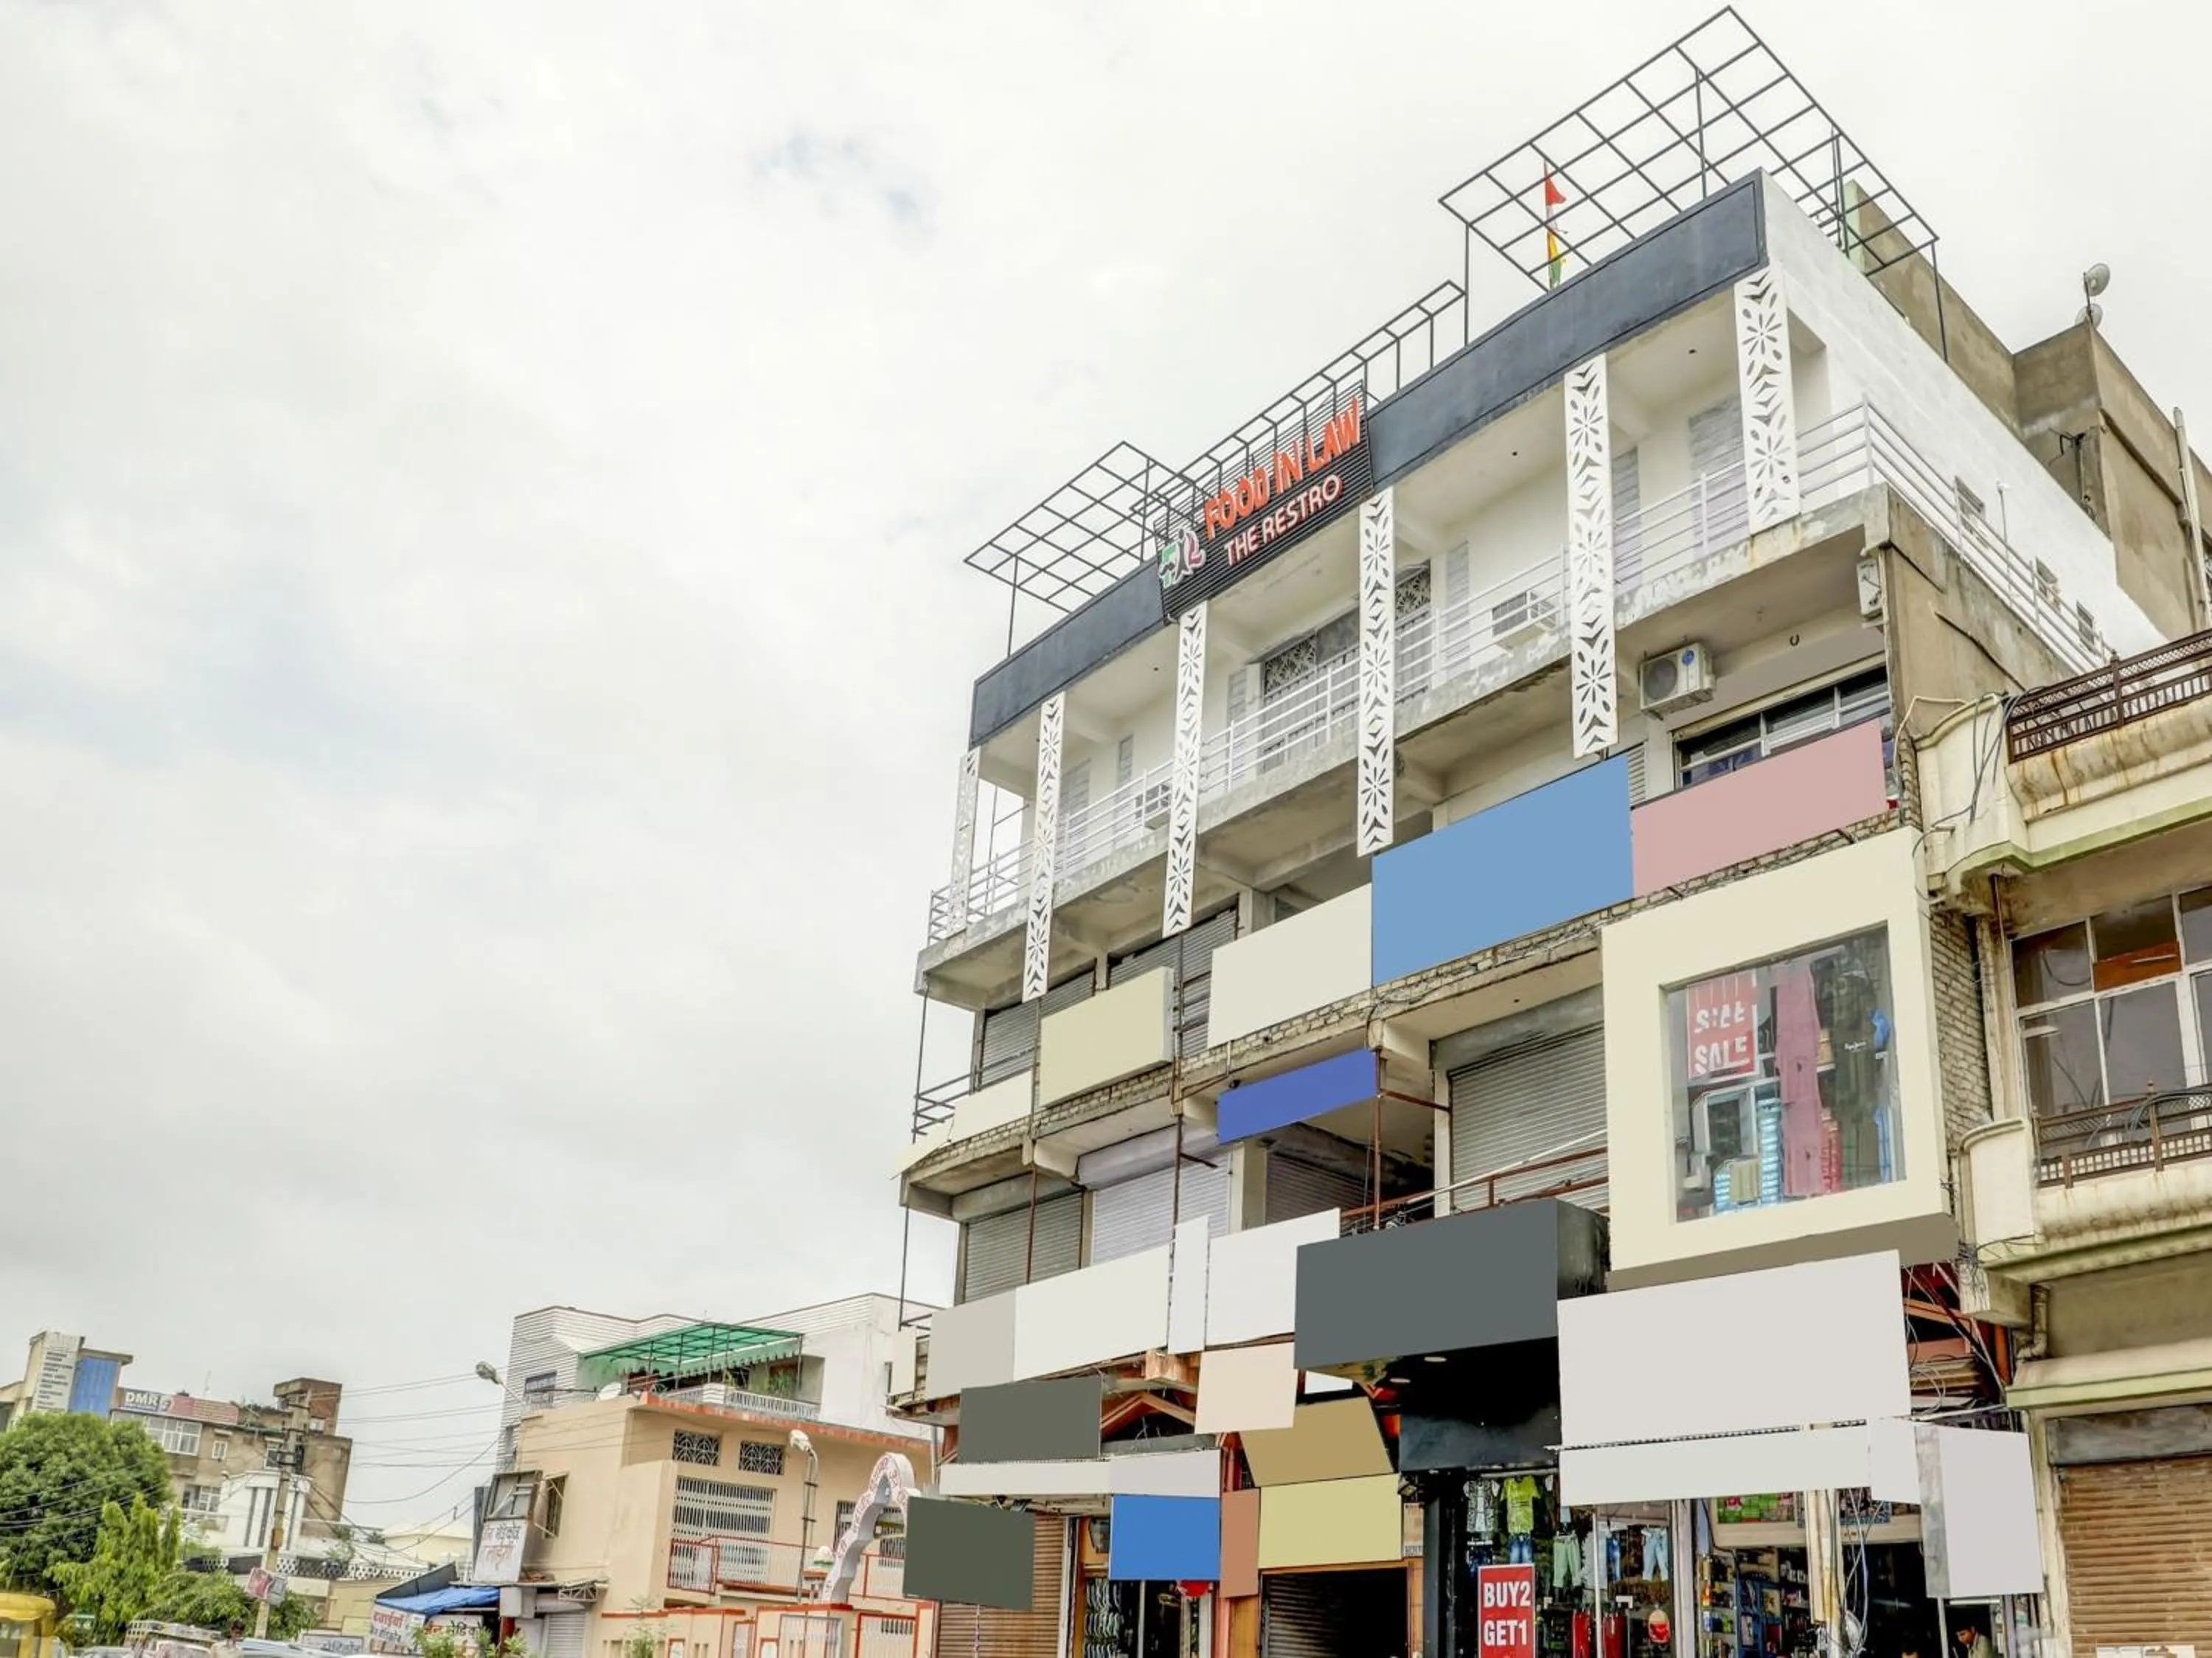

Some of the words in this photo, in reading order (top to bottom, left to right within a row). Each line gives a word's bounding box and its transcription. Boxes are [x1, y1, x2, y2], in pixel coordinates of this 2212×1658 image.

[1203, 466, 1270, 541] FOOD
[1273, 440, 1304, 496] IN
[1305, 395, 1361, 473] LAW
[1224, 528, 1260, 567] THE
[1262, 474, 1345, 544] RESTRO
[1694, 1036, 1750, 1075] SALE
